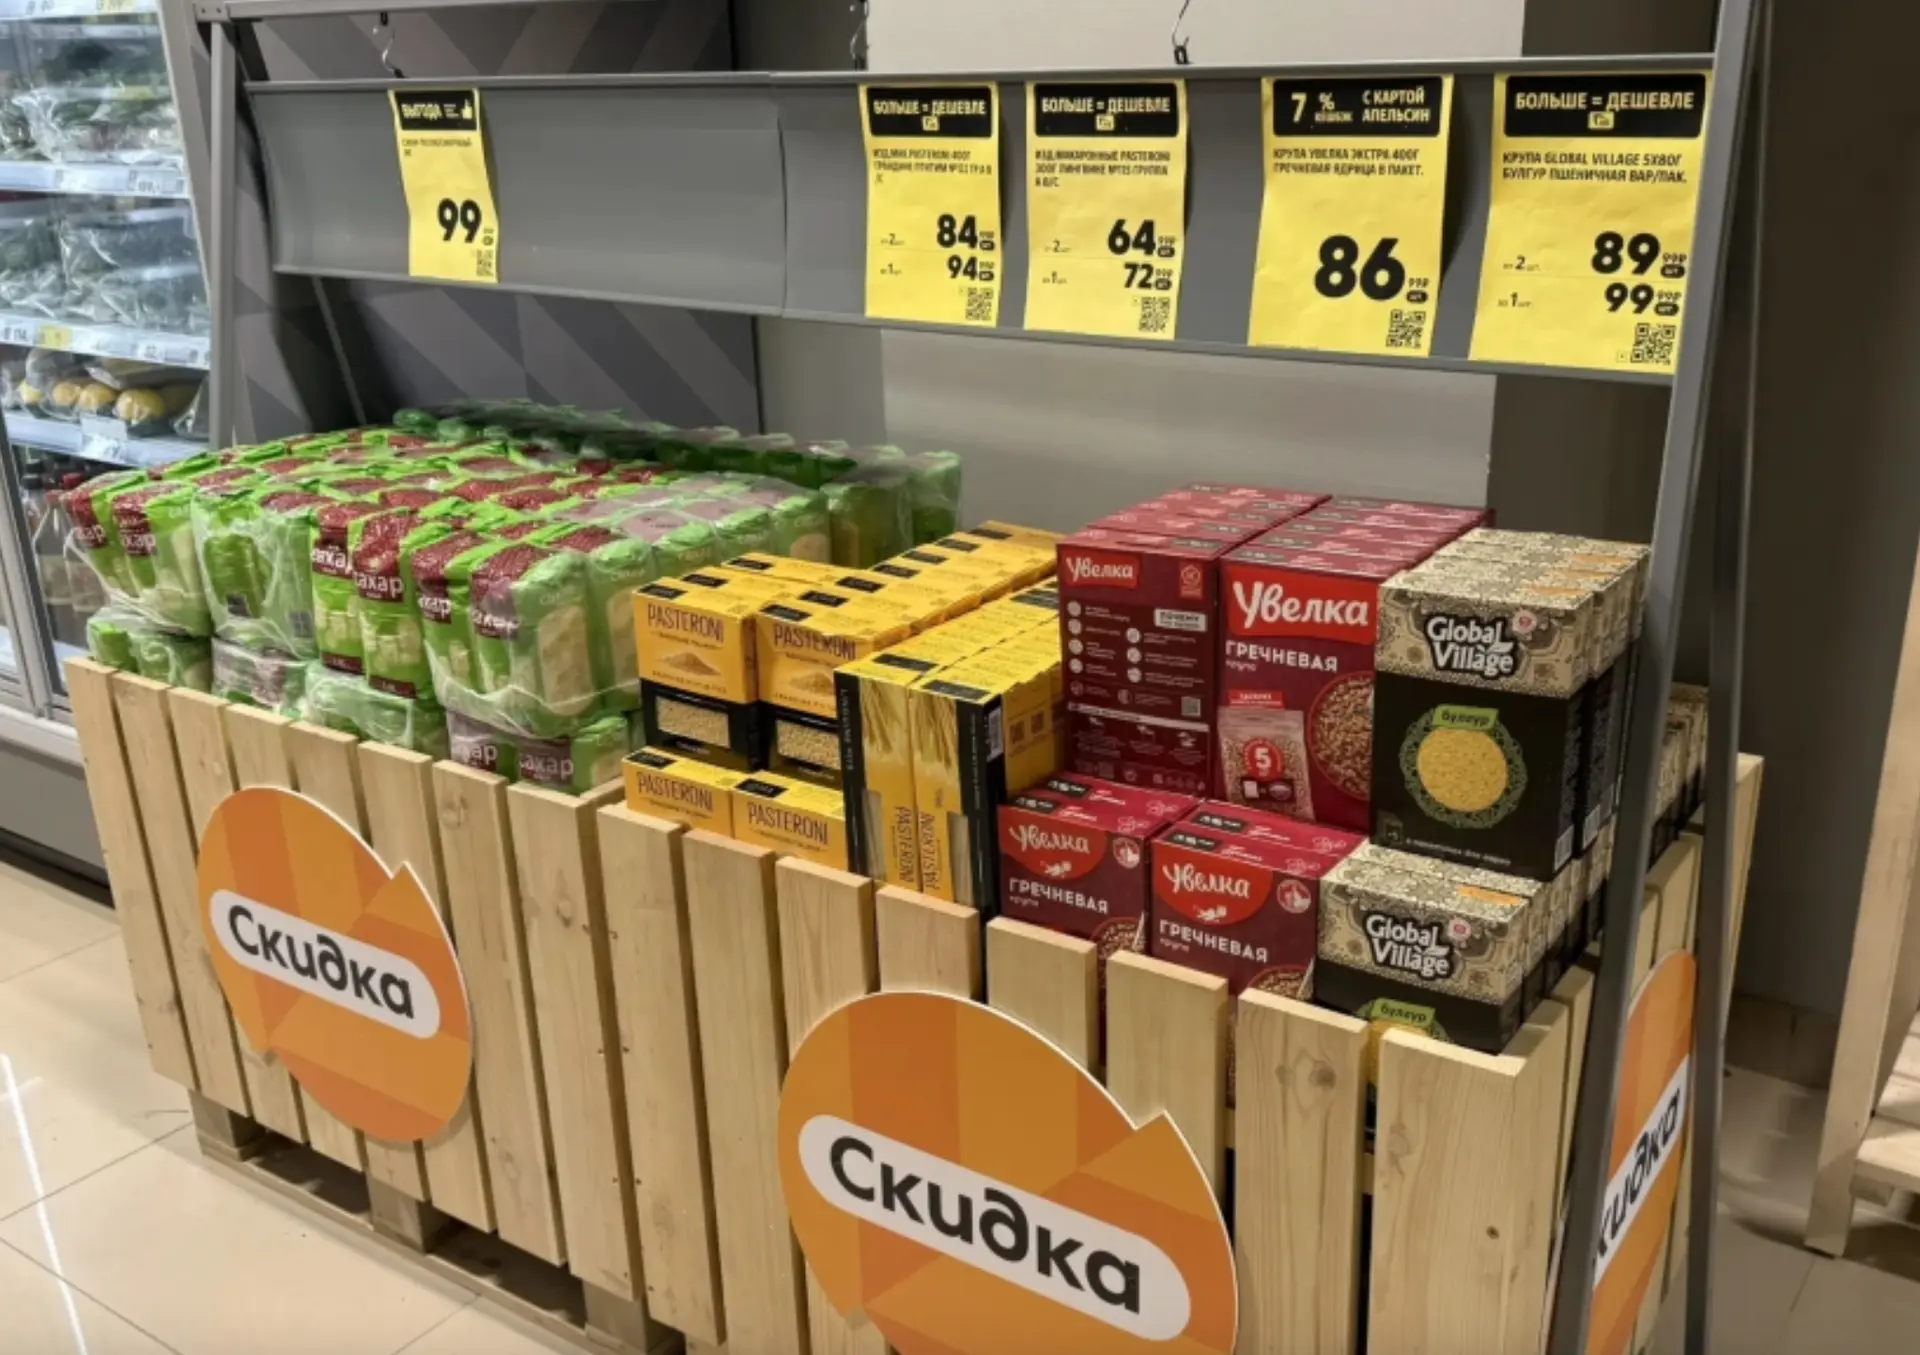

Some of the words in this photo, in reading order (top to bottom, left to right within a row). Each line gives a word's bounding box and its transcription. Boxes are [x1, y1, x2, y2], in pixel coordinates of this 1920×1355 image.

[873, 100, 919, 115] БОЛЬШЕ
[931, 99, 986, 116] ДЕШЕВЛЕ
[1042, 97, 1094, 113] БОЛЬШЕ
[1107, 96, 1171, 114] ДЕШЕВЛЕ
[1292, 92, 1307, 122] 7
[1319, 92, 1335, 110] %
[1362, 90, 1372, 104] С
[1374, 86, 1425, 104] КАРТОЙ
[1515, 92, 1588, 110] БОЛЬШЕ
[1605, 91, 1694, 112] ДЕШЕВЛЕ
[1362, 108, 1431, 123] АПЕЛЬСИН
[1274, 148, 1307, 160] КРУПА
[1309, 148, 1349, 160] УВЕЛКА
[1274, 162, 1331, 175] ГРЕЧНЕВАЯ
[1503, 152, 1541, 164] КРУПА
[1544, 152, 1588, 165] GLOBAL
[1592, 153, 1640, 166] VILLAGE
[1503, 167, 1546, 180] БУЛГУР
[1549, 168, 1626, 181] ПШЕНИЧНАЯ
[437, 198, 482, 244] 99
[937, 213, 978, 249] 84
[1108, 218, 1156, 256] 64
[947, 254, 977, 281] 94
[1314, 234, 1406, 301] 86
[1515, 254, 1525, 270] 2
[1591, 231, 1660, 276] 89
[1124, 262, 1154, 289] 72
[1511, 292, 1518, 307] 1
[1604, 282, 1654, 314] 99
[1065, 556, 1133, 582] Увелка
[1232, 581, 1369, 629] Увелка
[647, 603, 724, 643] PASTERONI
[1426, 615, 1504, 647] Global
[1225, 639, 1338, 673] ГРЕЧНЕВАЯ
[1433, 642, 1514, 677] Village
[1255, 746, 1272, 769] 5
[636, 771, 713, 812] PASTERONI
[748, 801, 828, 845] PASTERONI
[1008, 823, 1090, 854] Увелка
[1009, 877, 1109, 915] ГРЕЧНЕВАЯ
[1162, 863, 1250, 899] Увелка
[1159, 919, 1268, 963] ГРЕЧНЕВАЯ
[1366, 914, 1438, 948] Global
[228, 904, 414, 1019] Скидка
[1372, 938, 1450, 976] Village
[1593, 1087, 1680, 1262] кидка
[830, 1135, 1140, 1315] Скидка
